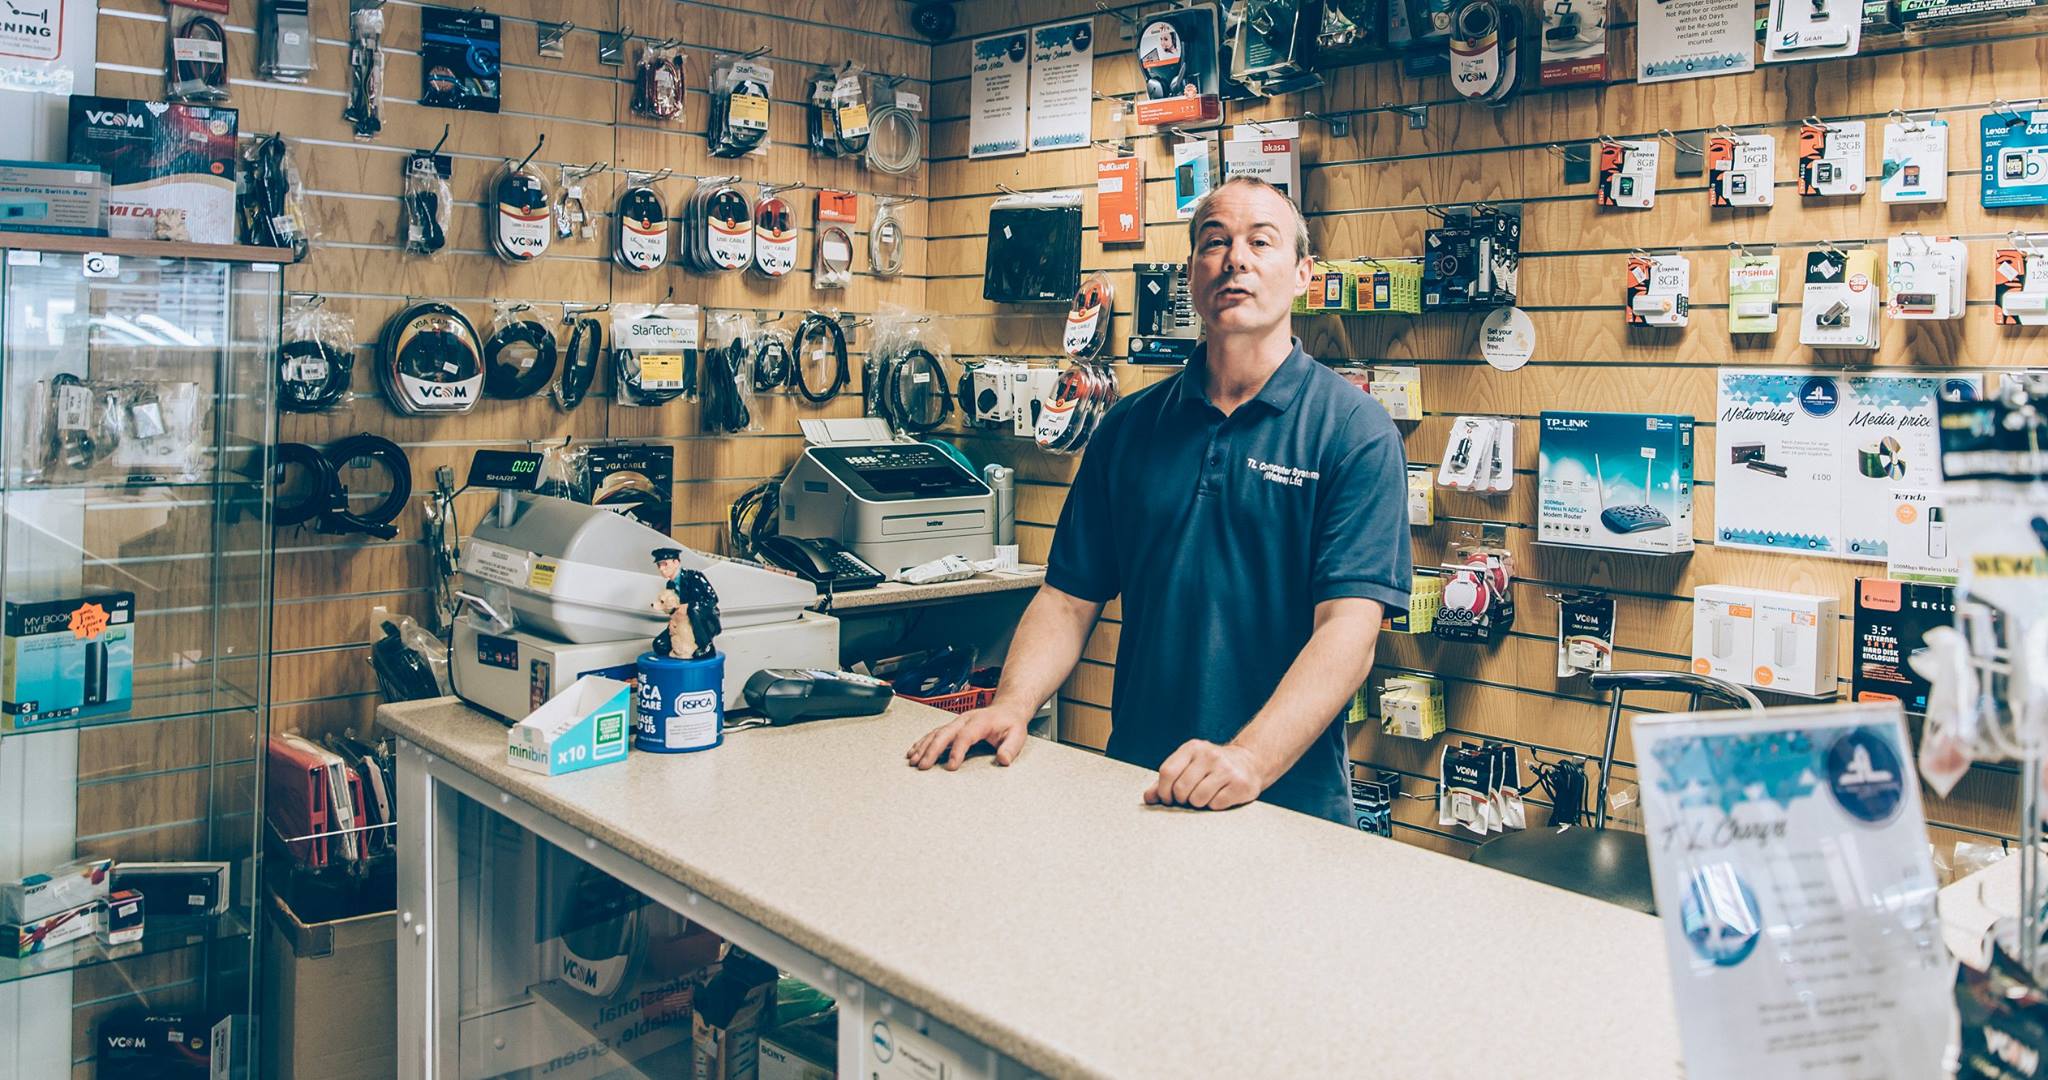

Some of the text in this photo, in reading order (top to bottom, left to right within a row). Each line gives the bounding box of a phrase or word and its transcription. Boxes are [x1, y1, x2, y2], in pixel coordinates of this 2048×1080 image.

[1711, 3, 1738, 12] collected
[0, 21, 52, 37] NING
[1677, 32, 1699, 40] reclaim
[1458, 71, 1488, 83] VCOM
[85, 110, 144, 129] VCOM
[1985, 127, 2010, 136] Lexar
[1263, 143, 1286, 152] akasa
[1835, 141, 1861, 152] 32GB
[1636, 159, 1655, 167] 8GB
[1743, 154, 1768, 164] 16GB
[1098, 161, 1131, 173] BullGuard
[1236, 168, 1245, 176] port
[1257, 166, 1272, 175] panel
[45, 187, 71, 196] Switch
[509, 236, 543, 248] VCOM
[629, 250, 661, 263] VCOM
[716, 250, 747, 262] VCOM
[762, 257, 792, 269] VCOM
[1736, 269, 1774, 277] TOSHIBA
[1658, 275, 1679, 286] 8GB
[412, 319, 429, 330] VGA
[631, 324, 696, 338] StarTech.com
[1066, 336, 1088, 348] VCOM
[418, 385, 467, 398] VCOM
[1721, 407, 1796, 426] Networking
[1848, 411, 1897, 427] Media
[1545, 418, 1589, 428] TP-LINK
[1038, 427, 1060, 438] VCOM
[605, 461, 648, 470] VGA CABLE
[1247, 457, 1258, 469] TL
[1258, 461, 1292, 476] Computer
[486, 474, 517, 482] SHARP
[1289, 475, 1303, 487] Ltd
[1563, 512, 1582, 520] Router
[1918, 565, 1942, 574] Wireless
[24, 616, 41, 627] MY
[42, 613, 72, 625] BOOK
[1437, 606, 1474, 622] GoGo
[1574, 612, 1599, 624] VCOM
[24, 624, 48, 635] LIVE
[1863, 633, 1898, 645] EXTERNAL
[1862, 646, 1899, 657] HARD DISK
[1862, 652, 1899, 663] ENCLOSURE
[21, 702, 32, 713] 3
[641, 699, 662, 711] CARE
[682, 697, 712, 710] RSPCA
[644, 724, 656, 735] US
[509, 744, 549, 765] minibin
[557, 744, 587, 766] x10
[1454, 764, 1478, 778] VCOM
[562, 955, 598, 989] VCOM
[107, 1036, 147, 1049] VCOM
[760, 1045, 786, 1064] SONY
